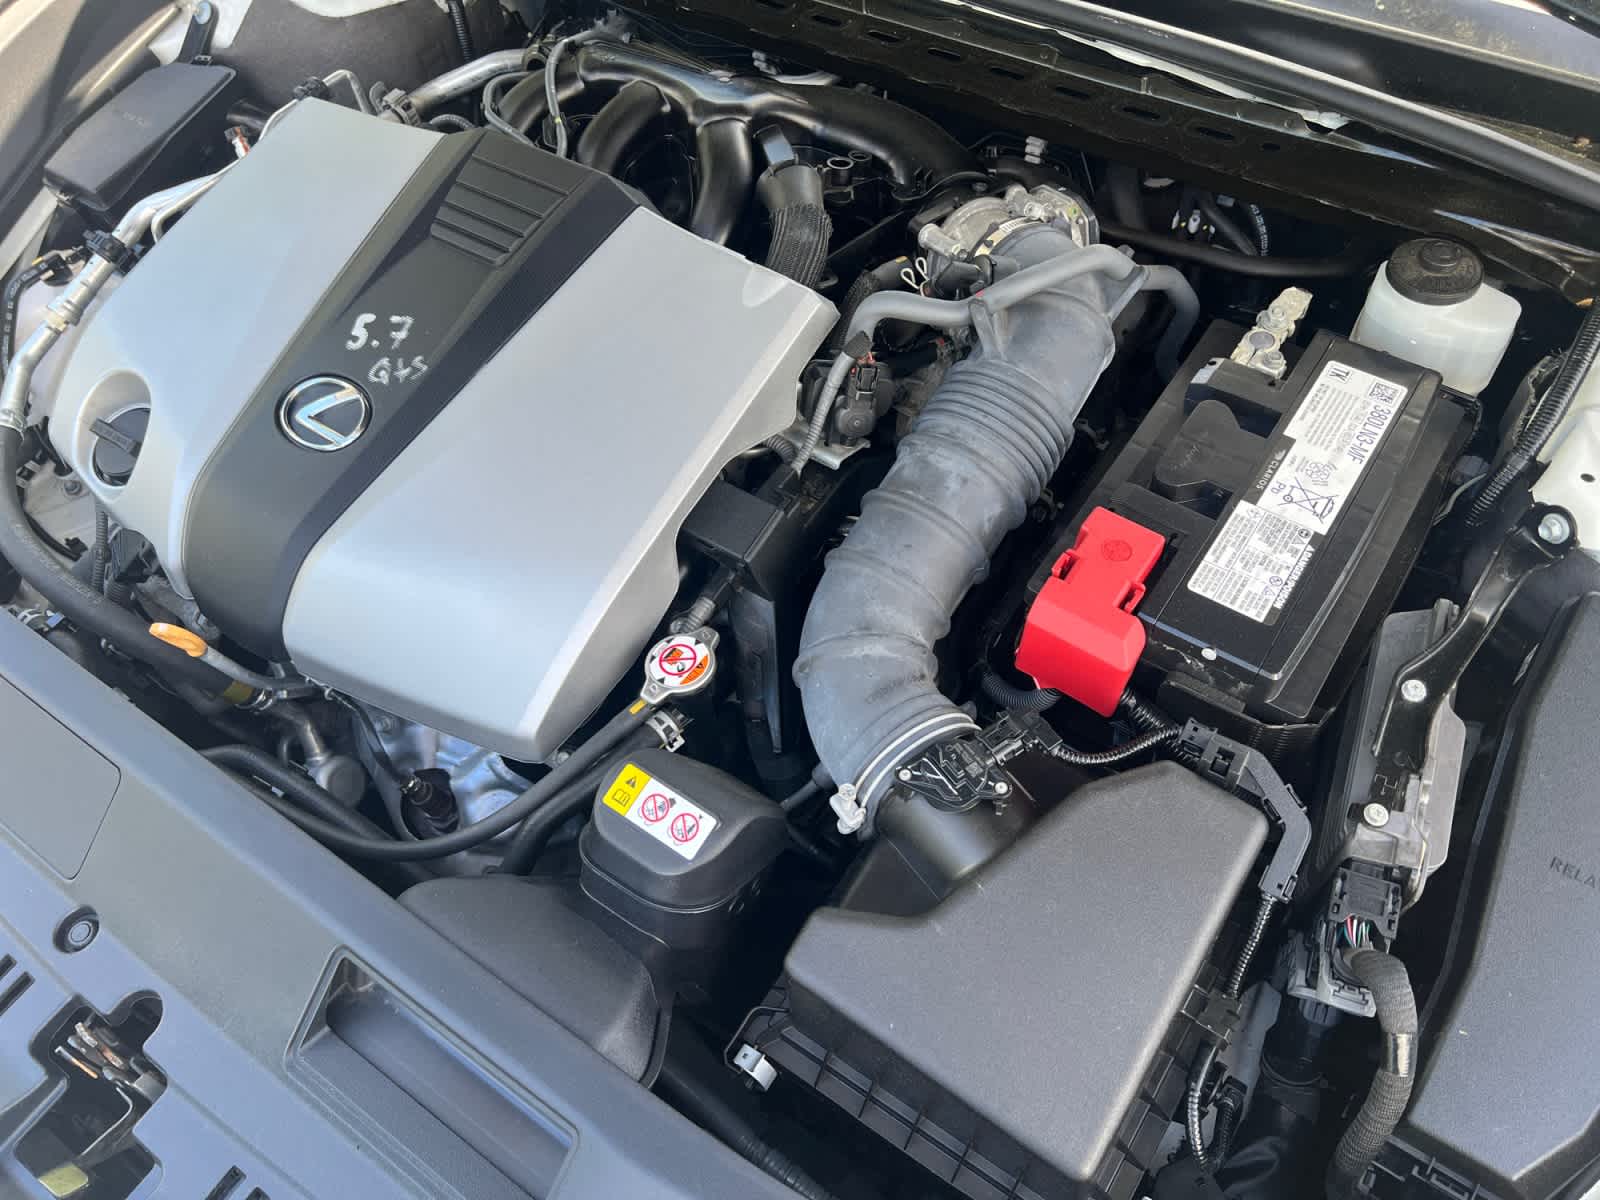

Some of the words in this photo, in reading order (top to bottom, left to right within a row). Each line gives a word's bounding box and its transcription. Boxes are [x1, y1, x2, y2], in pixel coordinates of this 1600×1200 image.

[345, 313, 414, 350] 5.7
[1255, 459, 1279, 491] CLARIOS
[1269, 480, 1286, 496] Pb
